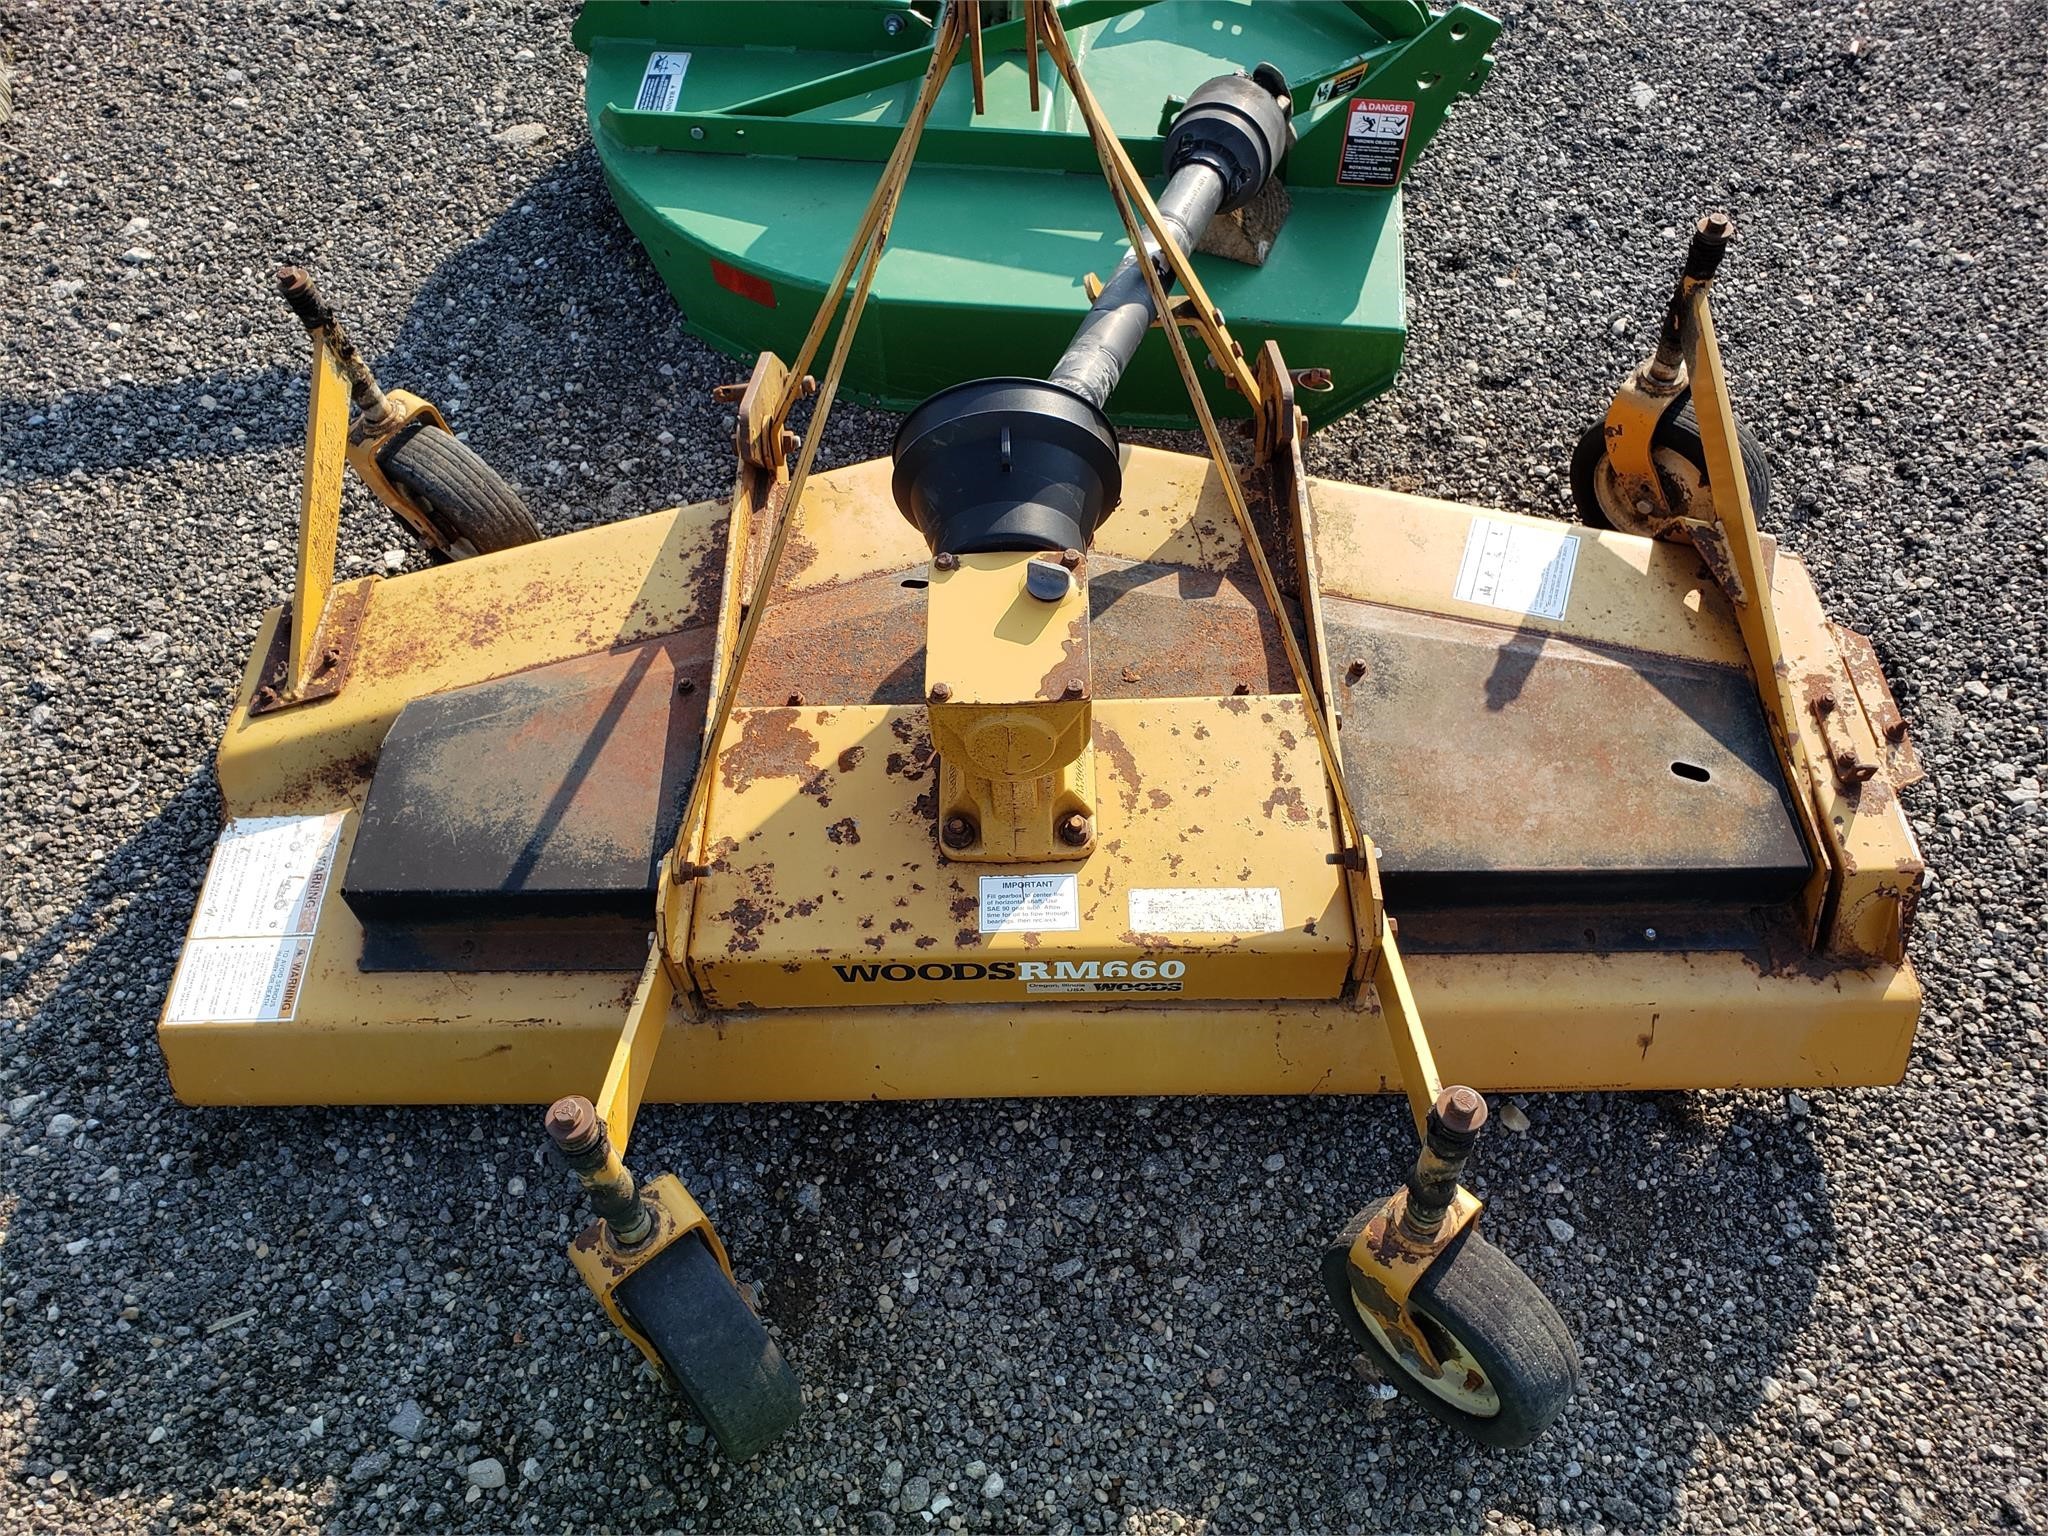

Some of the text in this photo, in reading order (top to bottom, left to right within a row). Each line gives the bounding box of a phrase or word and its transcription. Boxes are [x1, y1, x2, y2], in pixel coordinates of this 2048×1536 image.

[1368, 103, 1407, 112] DANGER
[305, 855, 327, 909] WARNING
[1002, 881, 1053, 889] IMPORTANT
[272, 951, 282, 972] INJURY
[269, 950, 290, 1008] TO AVOID SERIOUS
[269, 974, 276, 984] OR
[281, 962, 302, 1011] WARNING
[1093, 982, 1182, 992] WOODS
